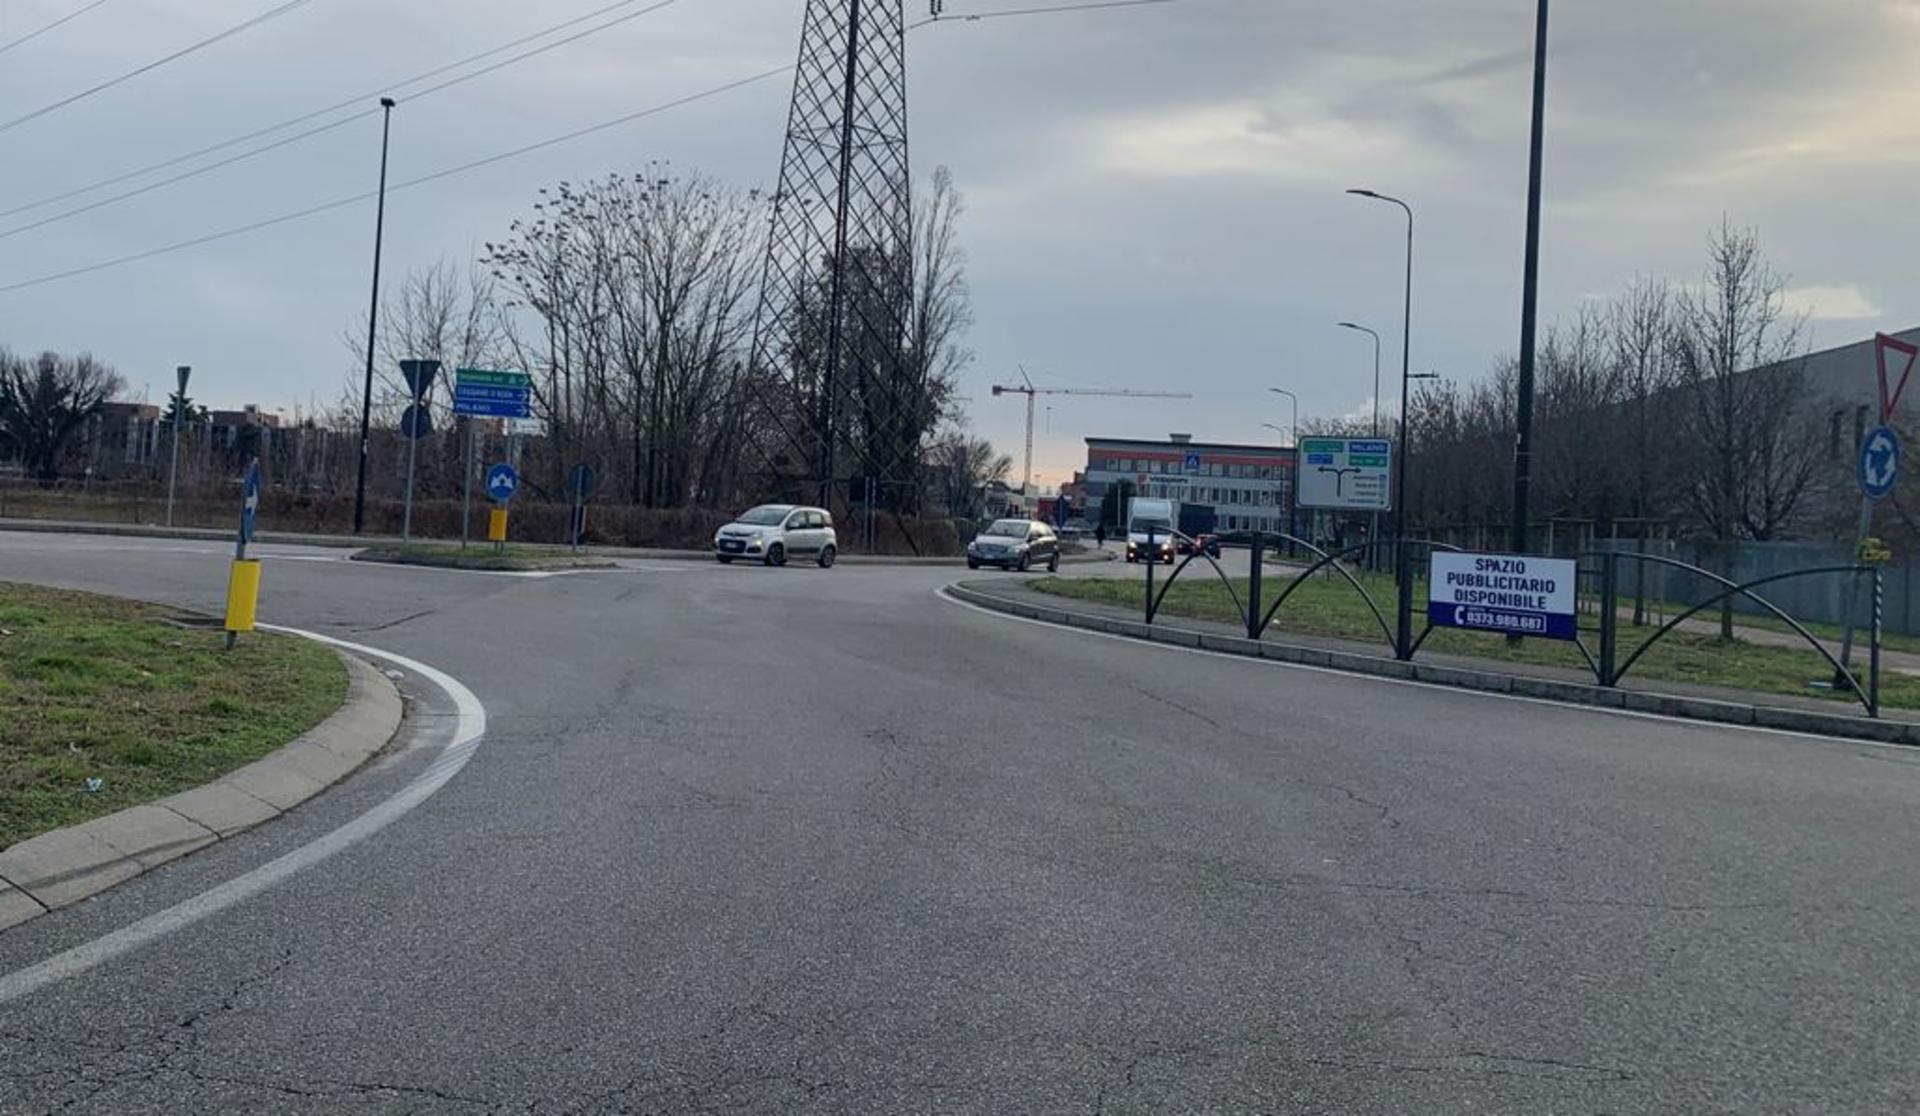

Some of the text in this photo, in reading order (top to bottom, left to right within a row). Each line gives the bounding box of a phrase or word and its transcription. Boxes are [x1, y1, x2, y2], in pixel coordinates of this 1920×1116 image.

[1475, 558, 1525, 574] SPAZIO
[1447, 572, 1555, 593] PUBBLICITARIO
[1454, 589, 1546, 609] DISPONIBILE
